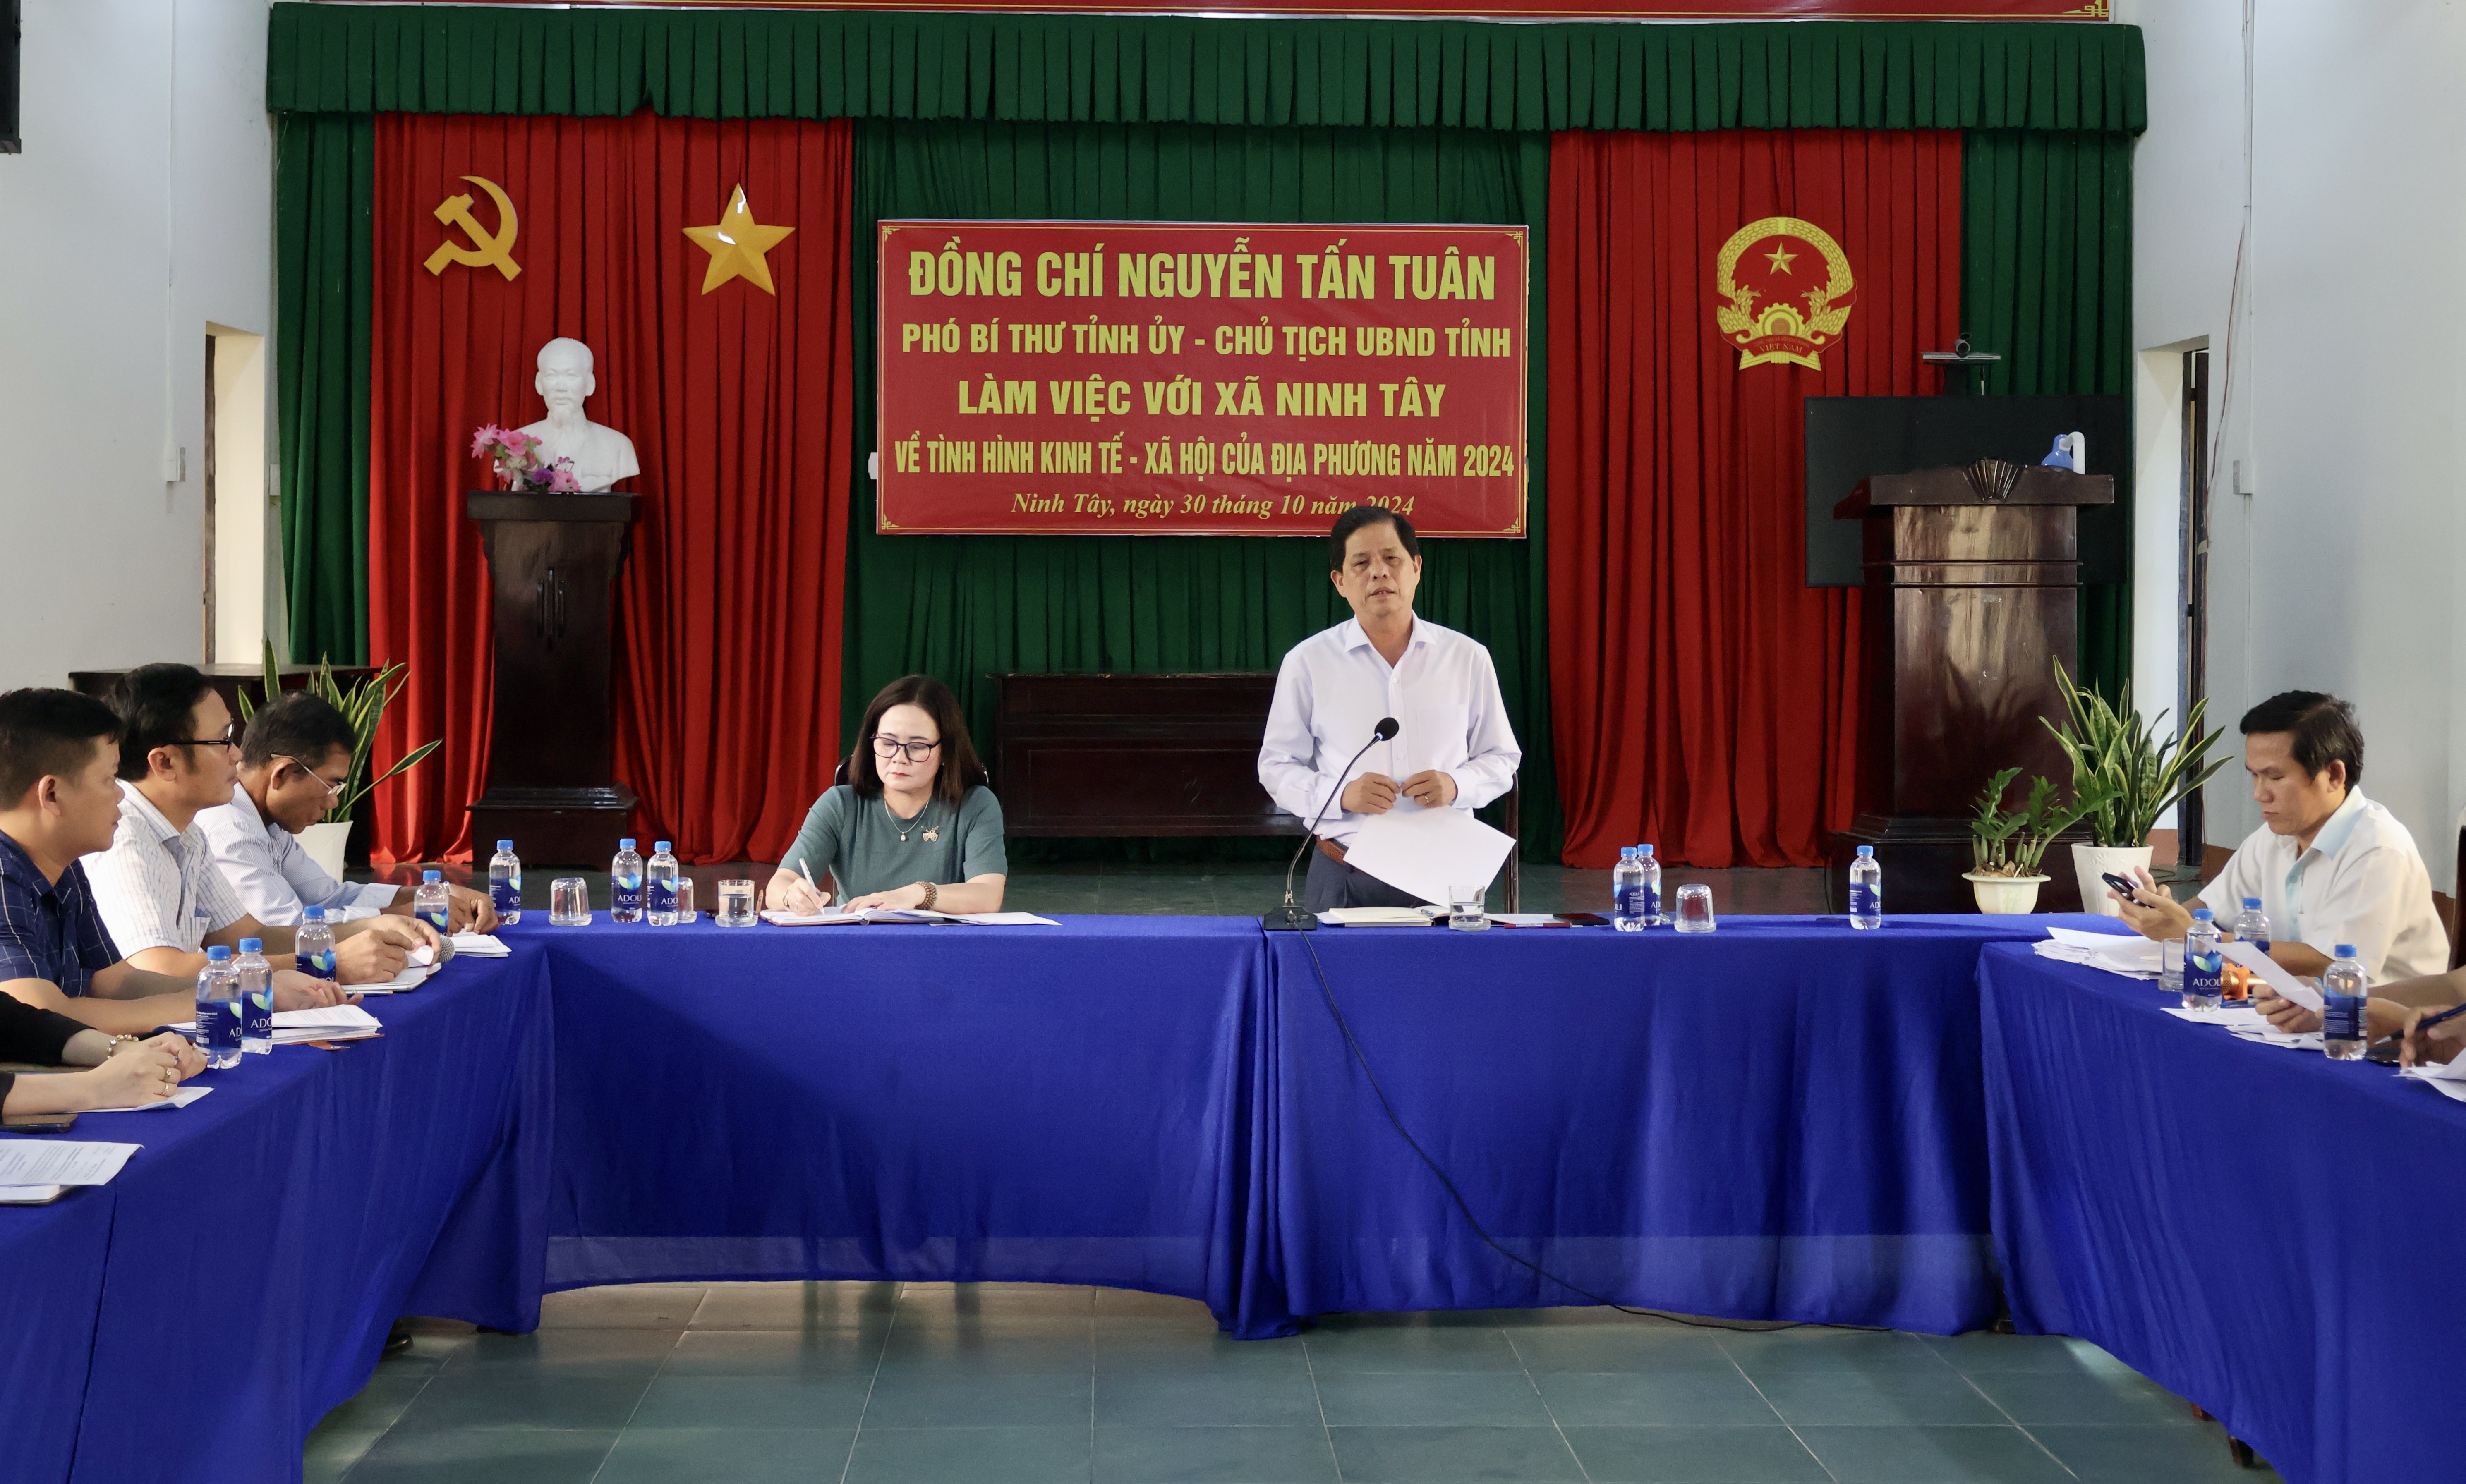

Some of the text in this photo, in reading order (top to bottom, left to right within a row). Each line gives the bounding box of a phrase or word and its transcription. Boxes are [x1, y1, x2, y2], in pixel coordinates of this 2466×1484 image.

[908, 236, 1495, 300] ĐỒNG CHÍ NGUYỄN TẤN TUÂN
[902, 317, 961, 353] PHÓ
[970, 317, 999, 353] BÍ
[1008, 321, 1066, 354] THƯ
[1072, 314, 1138, 354] TỈNH
[1148, 314, 1185, 354] ỦY
[1215, 316, 1273, 356] CHỦ
[1282, 326, 1346, 362] TỊCH
[1356, 327, 1436, 357] UBND
[1444, 317, 1510, 357] TỈNH
[959, 373, 1446, 422] LÀM VIỆC VỚI XÃ NINH TÂY
[894, 430, 920, 473] VỀ
[926, 433, 975, 473] TÌNH
[982, 434, 1034, 474] HÌNH
[1040, 441, 1092, 474] KINH
[1098, 431, 1124, 474] TẾ
[1144, 436, 1173, 474] XÃ
[1179, 435, 1215, 482] HỘI
[1222, 431, 1265, 475] CỦA
[1270, 443, 1307, 483] ĐỊA
[1313, 440, 1400, 476] PHƯƠNG
[1407, 437, 1457, 476] NĂM
[1463, 445, 1515, 477] 2024
[1011, 493, 1415, 519] Ninh Tây, ngày 30 tháng 10 năm 2024
